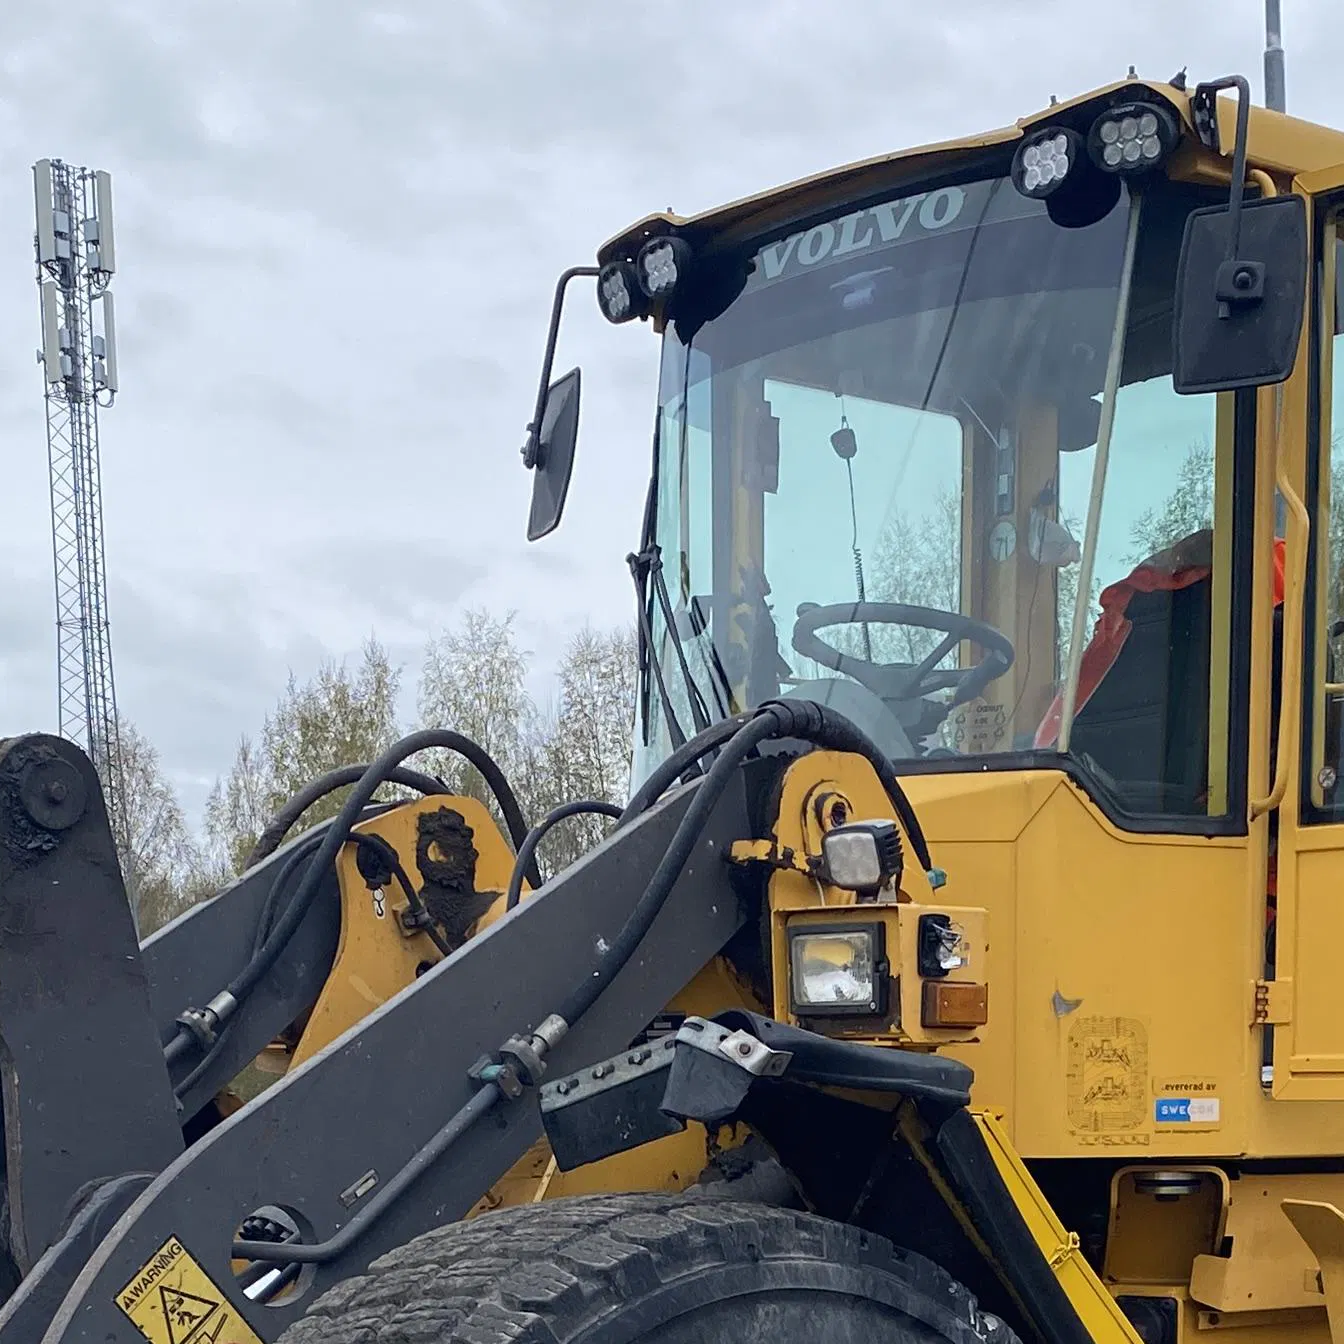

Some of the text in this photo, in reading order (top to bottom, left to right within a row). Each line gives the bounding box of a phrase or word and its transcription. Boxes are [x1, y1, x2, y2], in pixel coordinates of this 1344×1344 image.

[759, 184, 967, 281] VOLVO
[1161, 1082, 1217, 1091] evererad av
[129, 1242, 183, 1299] WARNING
